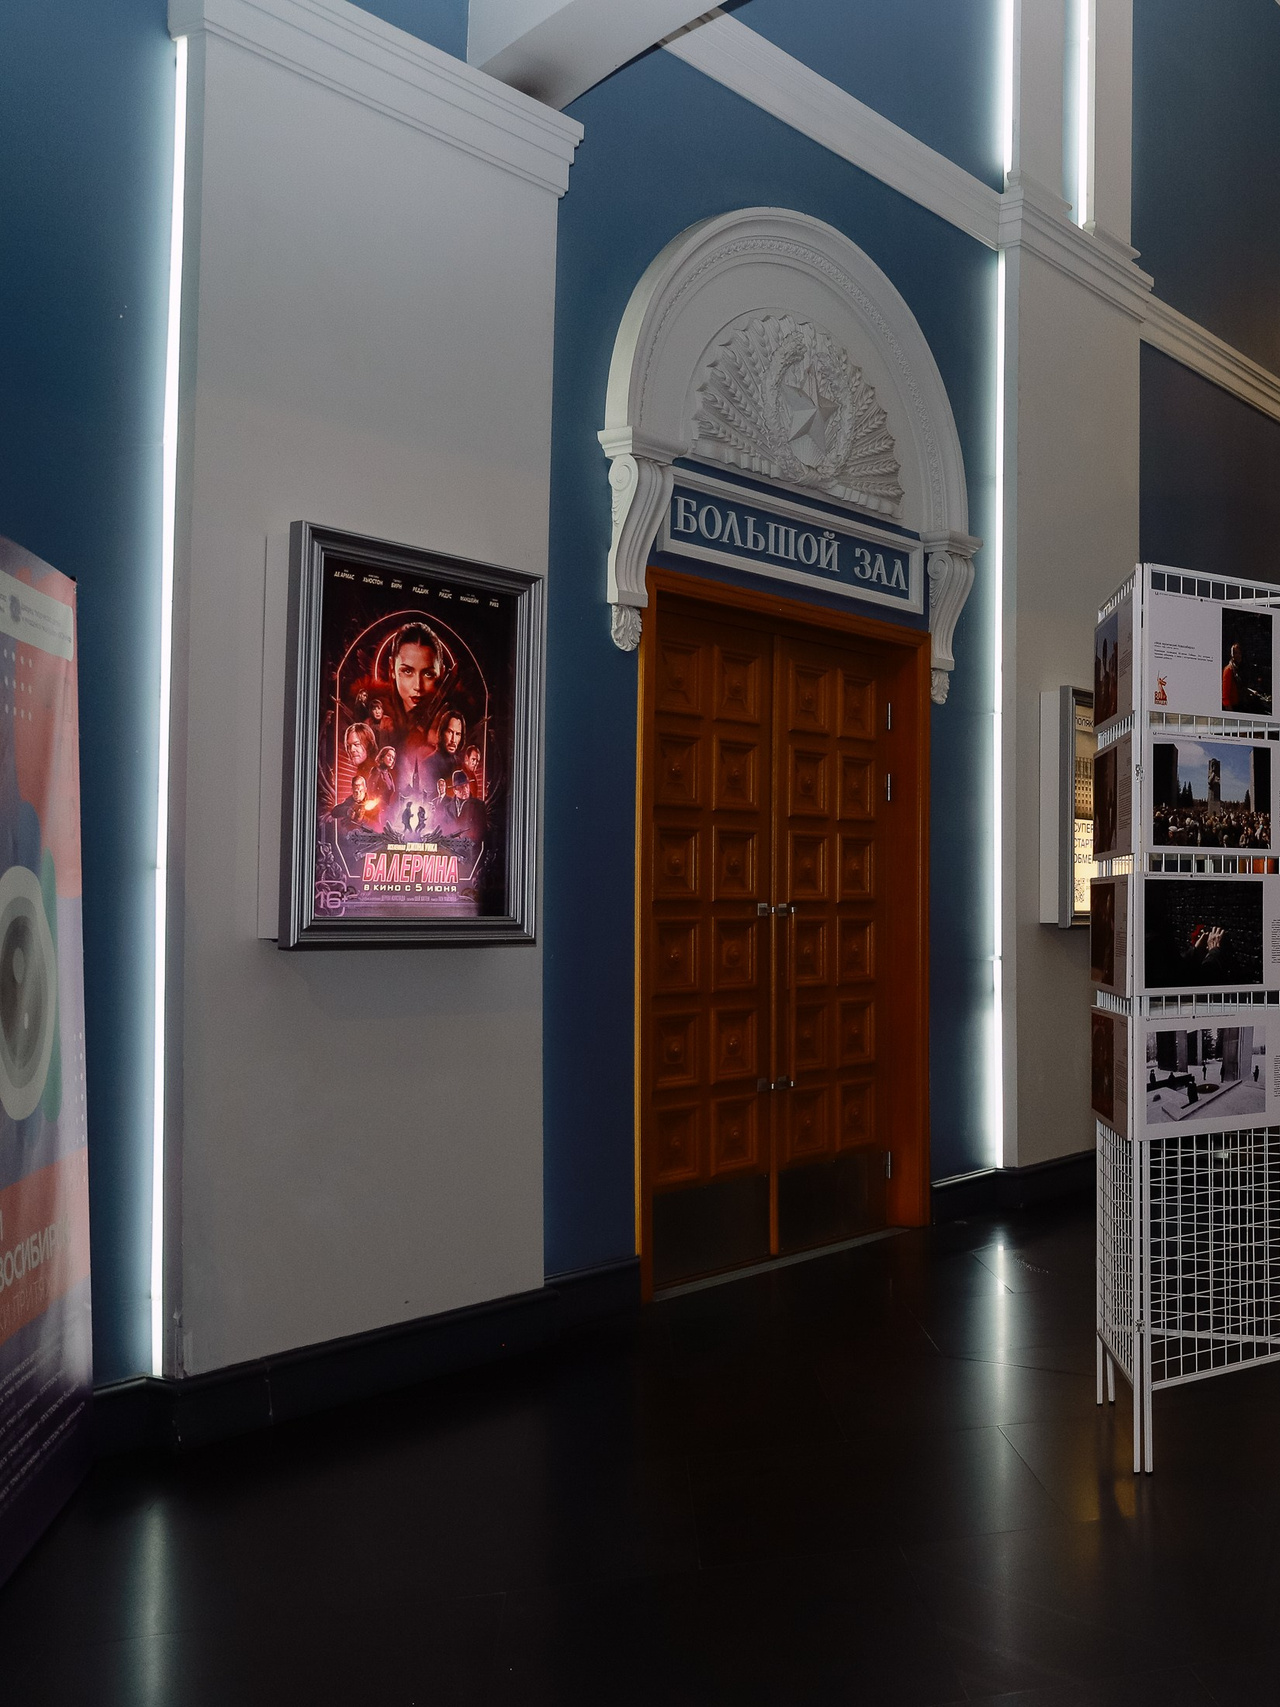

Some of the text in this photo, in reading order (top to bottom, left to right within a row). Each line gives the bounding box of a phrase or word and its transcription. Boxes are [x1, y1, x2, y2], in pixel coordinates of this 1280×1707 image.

[674, 496, 908, 591] БОЛЬШОЙ ЗАЛ
[363, 853, 459, 884] БАЛЕРИНА
[415, 883, 423, 892] 5
